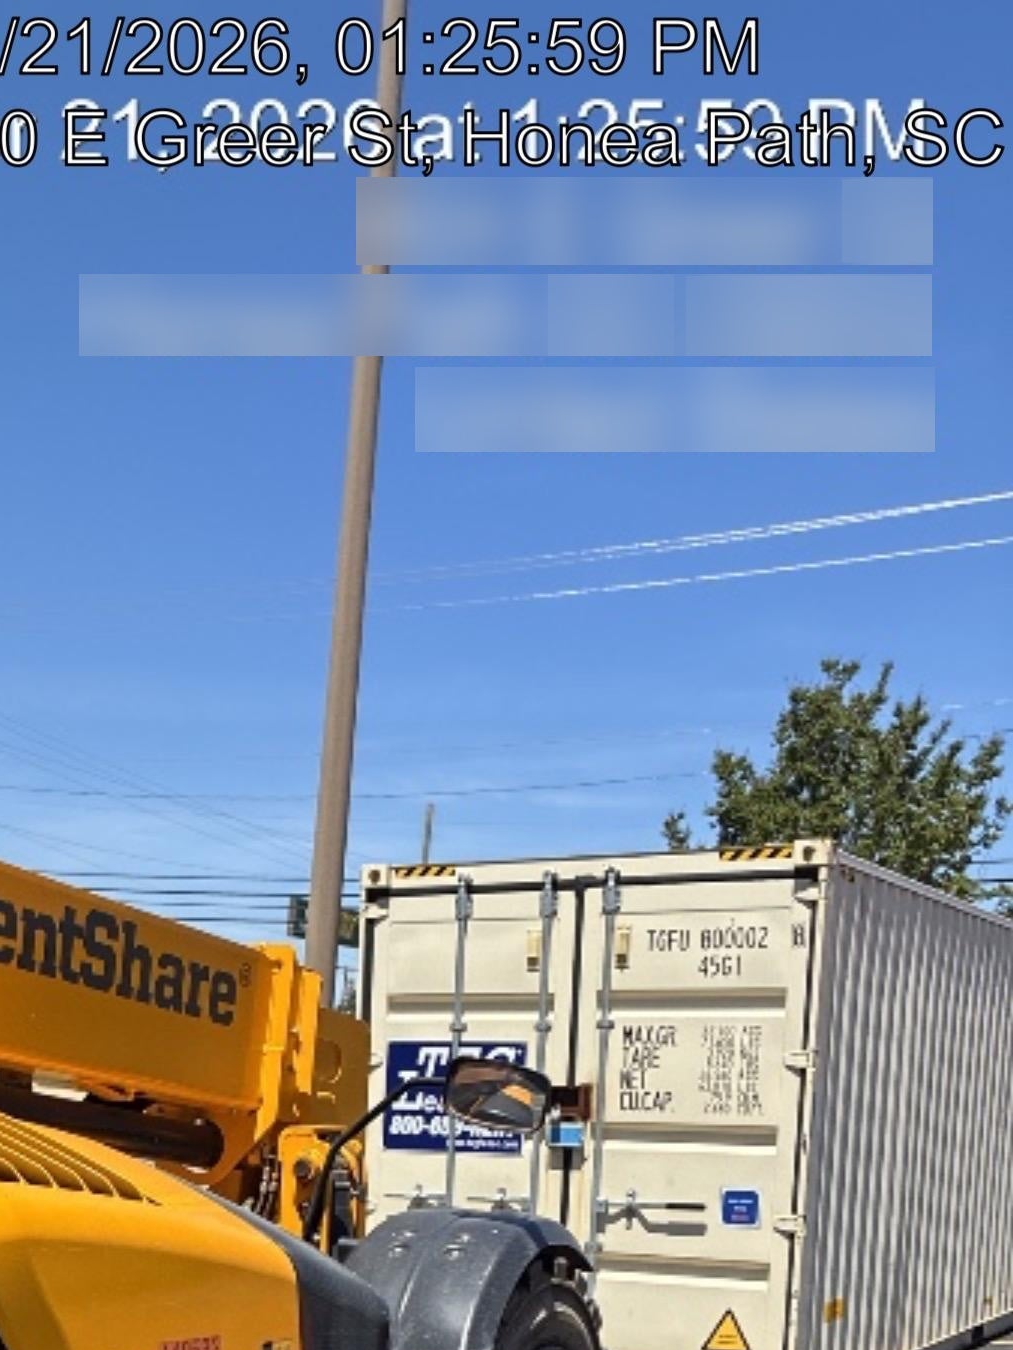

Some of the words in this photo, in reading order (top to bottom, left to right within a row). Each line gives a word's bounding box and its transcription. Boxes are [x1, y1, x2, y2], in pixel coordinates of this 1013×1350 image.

[647, 929, 690, 951] TGFU
[623, 1046, 660, 1068] TARE
[620, 1068, 647, 1089] NET
